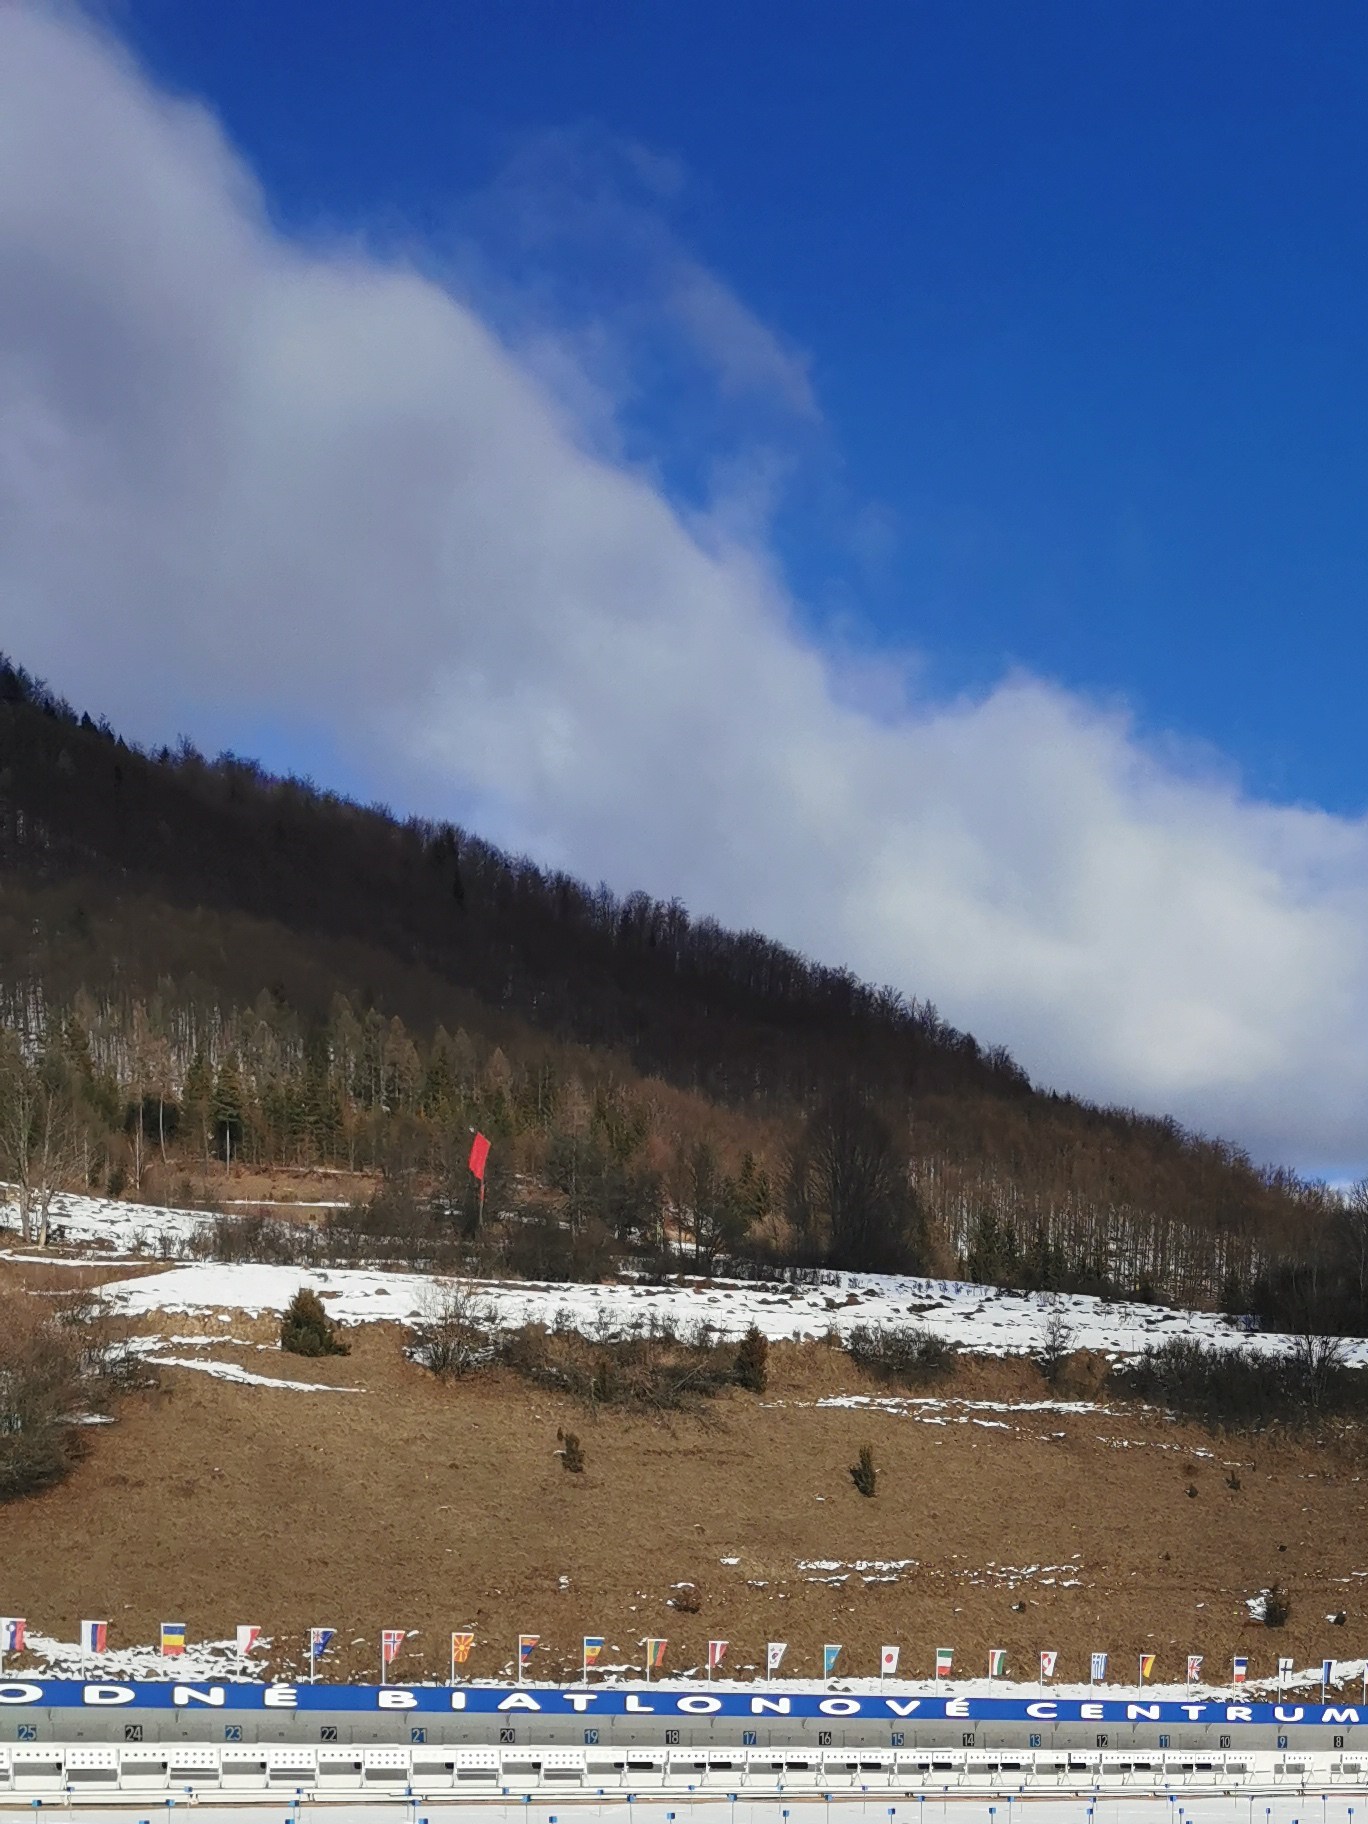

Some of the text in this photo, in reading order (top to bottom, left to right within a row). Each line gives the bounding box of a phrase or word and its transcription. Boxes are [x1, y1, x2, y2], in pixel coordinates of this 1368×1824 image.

[377, 1690, 970, 1717] BIATLONOVÉ
[1026, 1703, 1360, 1723] CENTRUM
[18, 1725, 36, 1740] 25
[126, 1726, 143, 1741] 24
[226, 1726, 242, 1741] 23
[321, 1726, 337, 1741] 22
[412, 1729, 427, 1743] 21
[500, 1729, 515, 1743] 20
[584, 1730, 598, 1744] 19
[666, 1730, 679, 1744] 18
[743, 1731, 756, 1745] 17
[819, 1732, 831, 1745] 16
[892, 1733, 904, 1746] 15
[963, 1733, 974, 1746] 14
[1030, 1734, 1041, 1747] 13
[1097, 1734, 1108, 1747] 12
[1160, 1735, 1170, 1747] 11
[1220, 1736, 1230, 1748] 10
[1279, 1736, 1286, 1748] 9
[1335, 1737, 1342, 1747] 8
